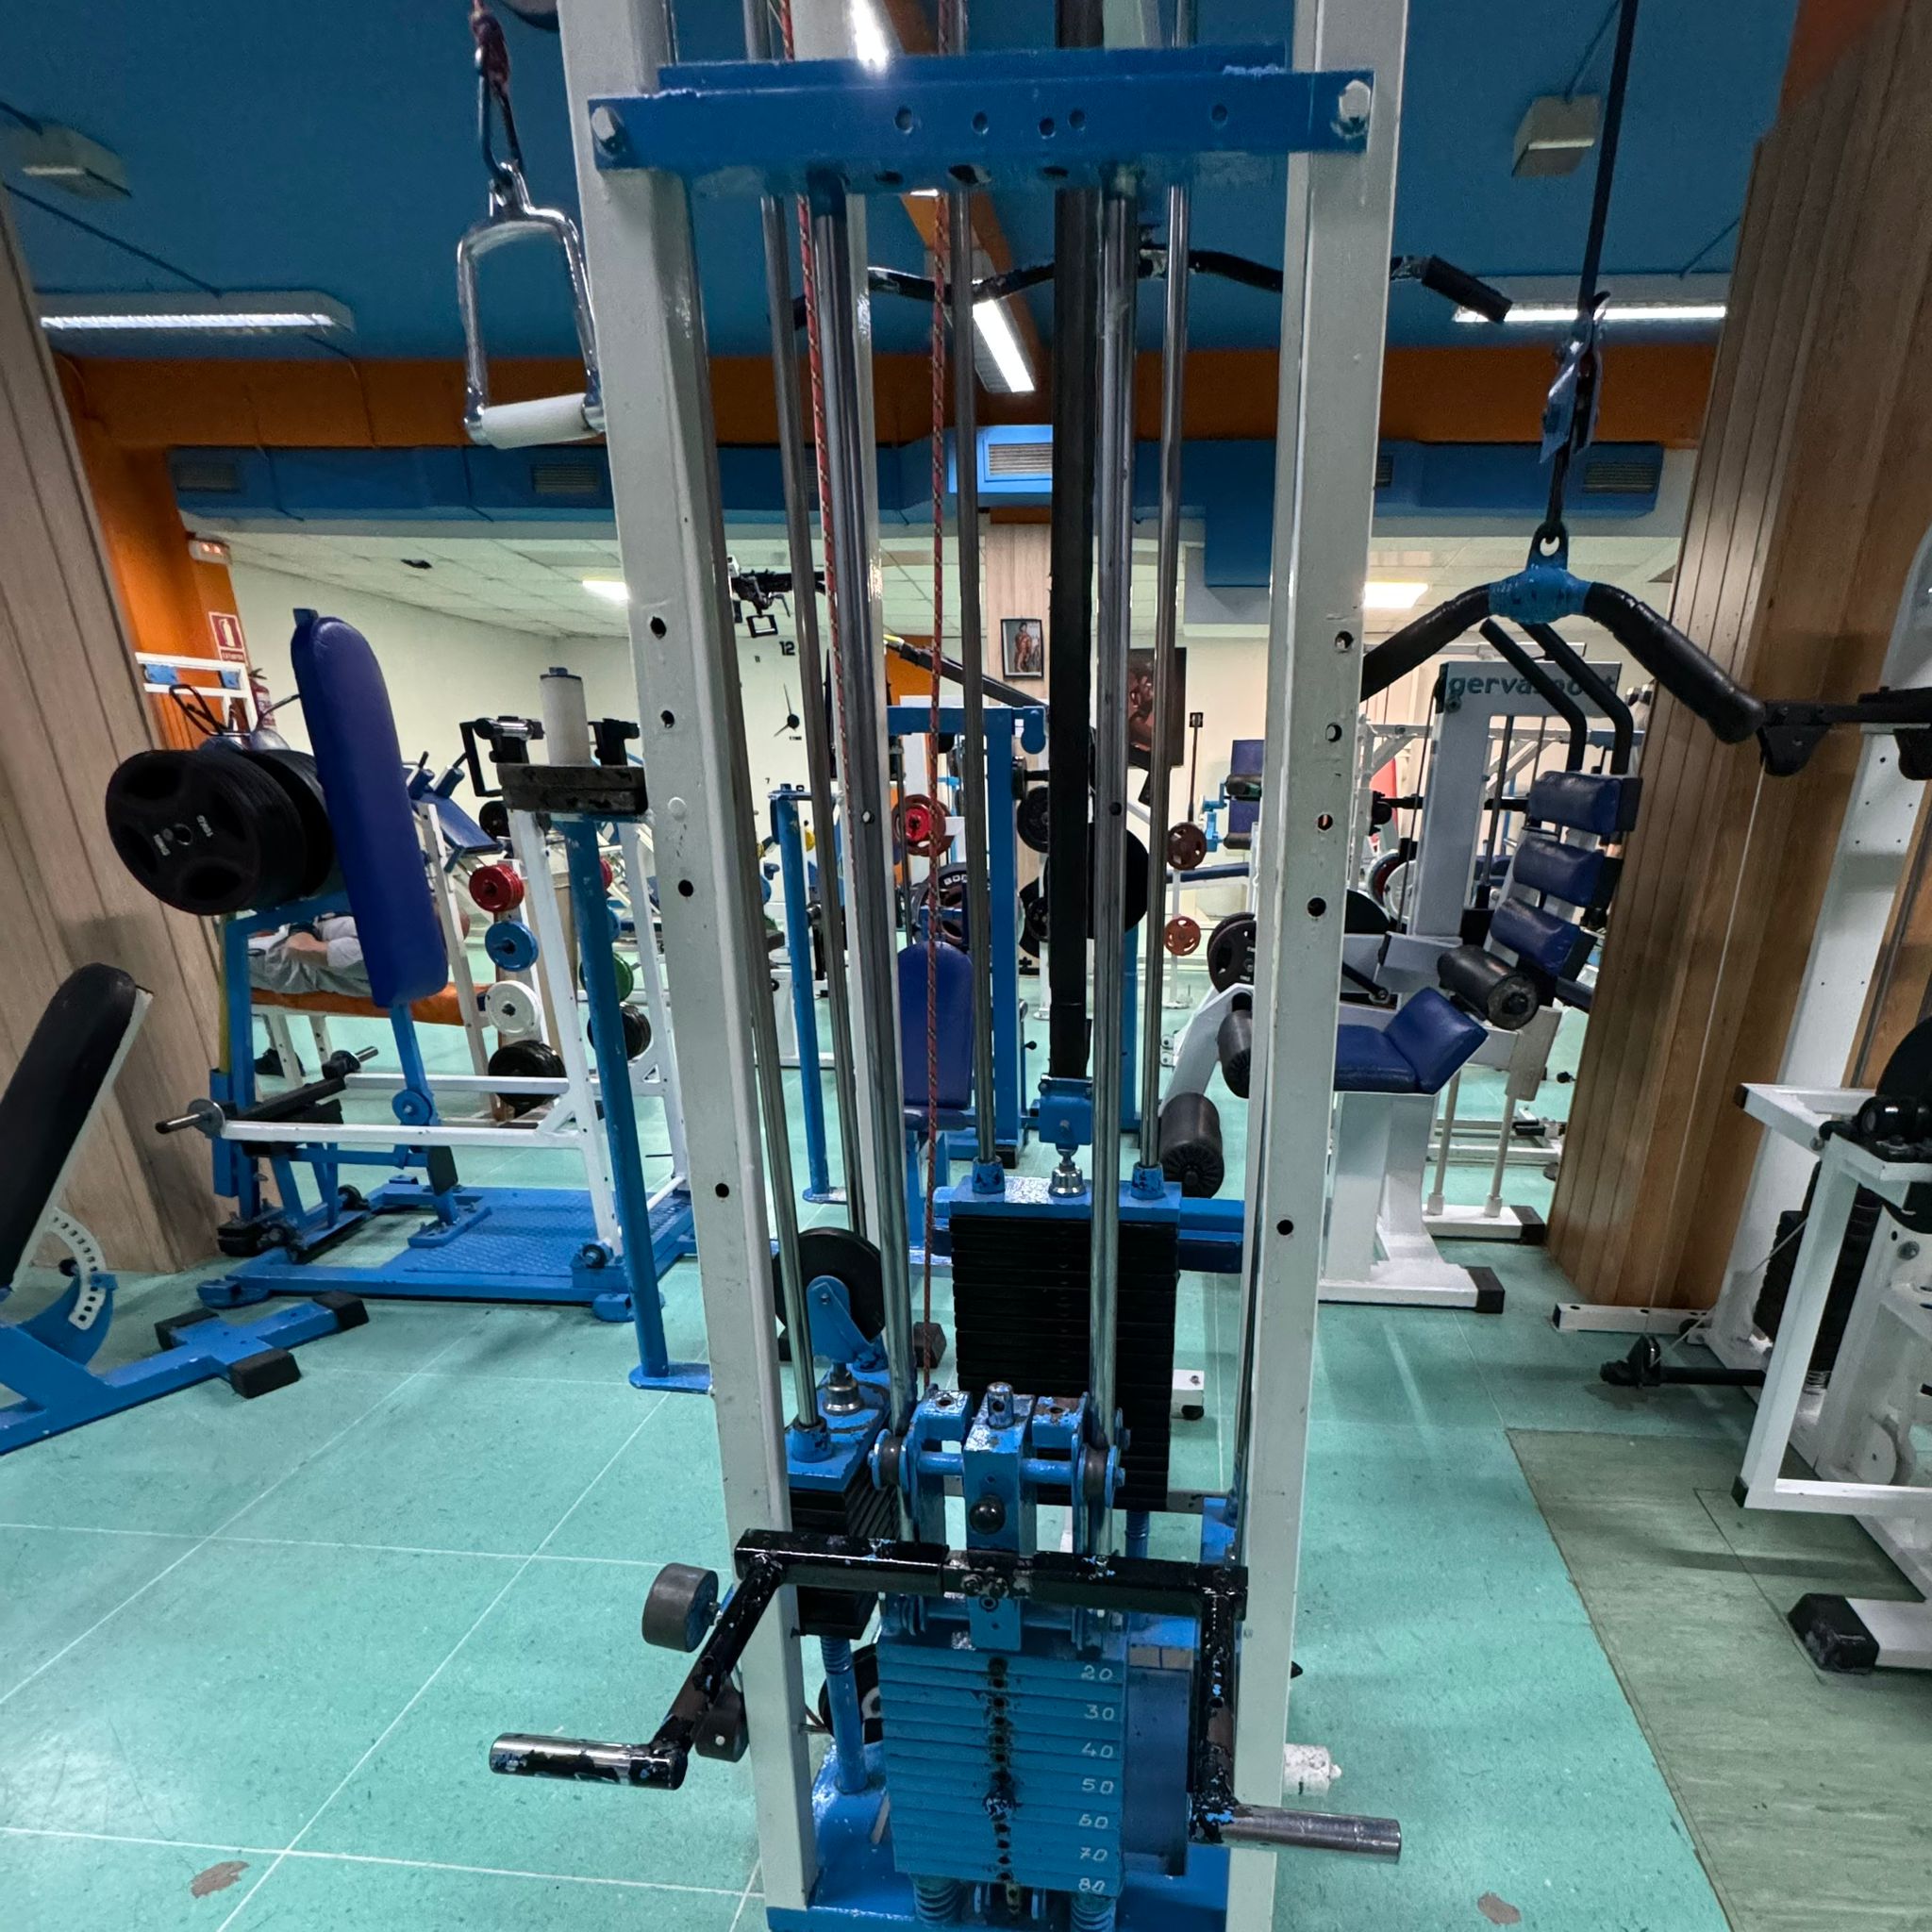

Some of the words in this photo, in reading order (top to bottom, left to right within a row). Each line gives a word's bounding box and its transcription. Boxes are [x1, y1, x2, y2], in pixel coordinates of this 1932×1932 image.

[779, 641, 795, 657] 12
[1080, 1664, 1114, 1681] 20
[1084, 1703, 1115, 1721] 30
[1081, 1741, 1114, 1759] 40
[1081, 1777, 1114, 1795] 50
[1078, 1813, 1109, 1829] 60
[1079, 1846, 1108, 1862] 70
[1078, 1877, 1106, 1894] 80
